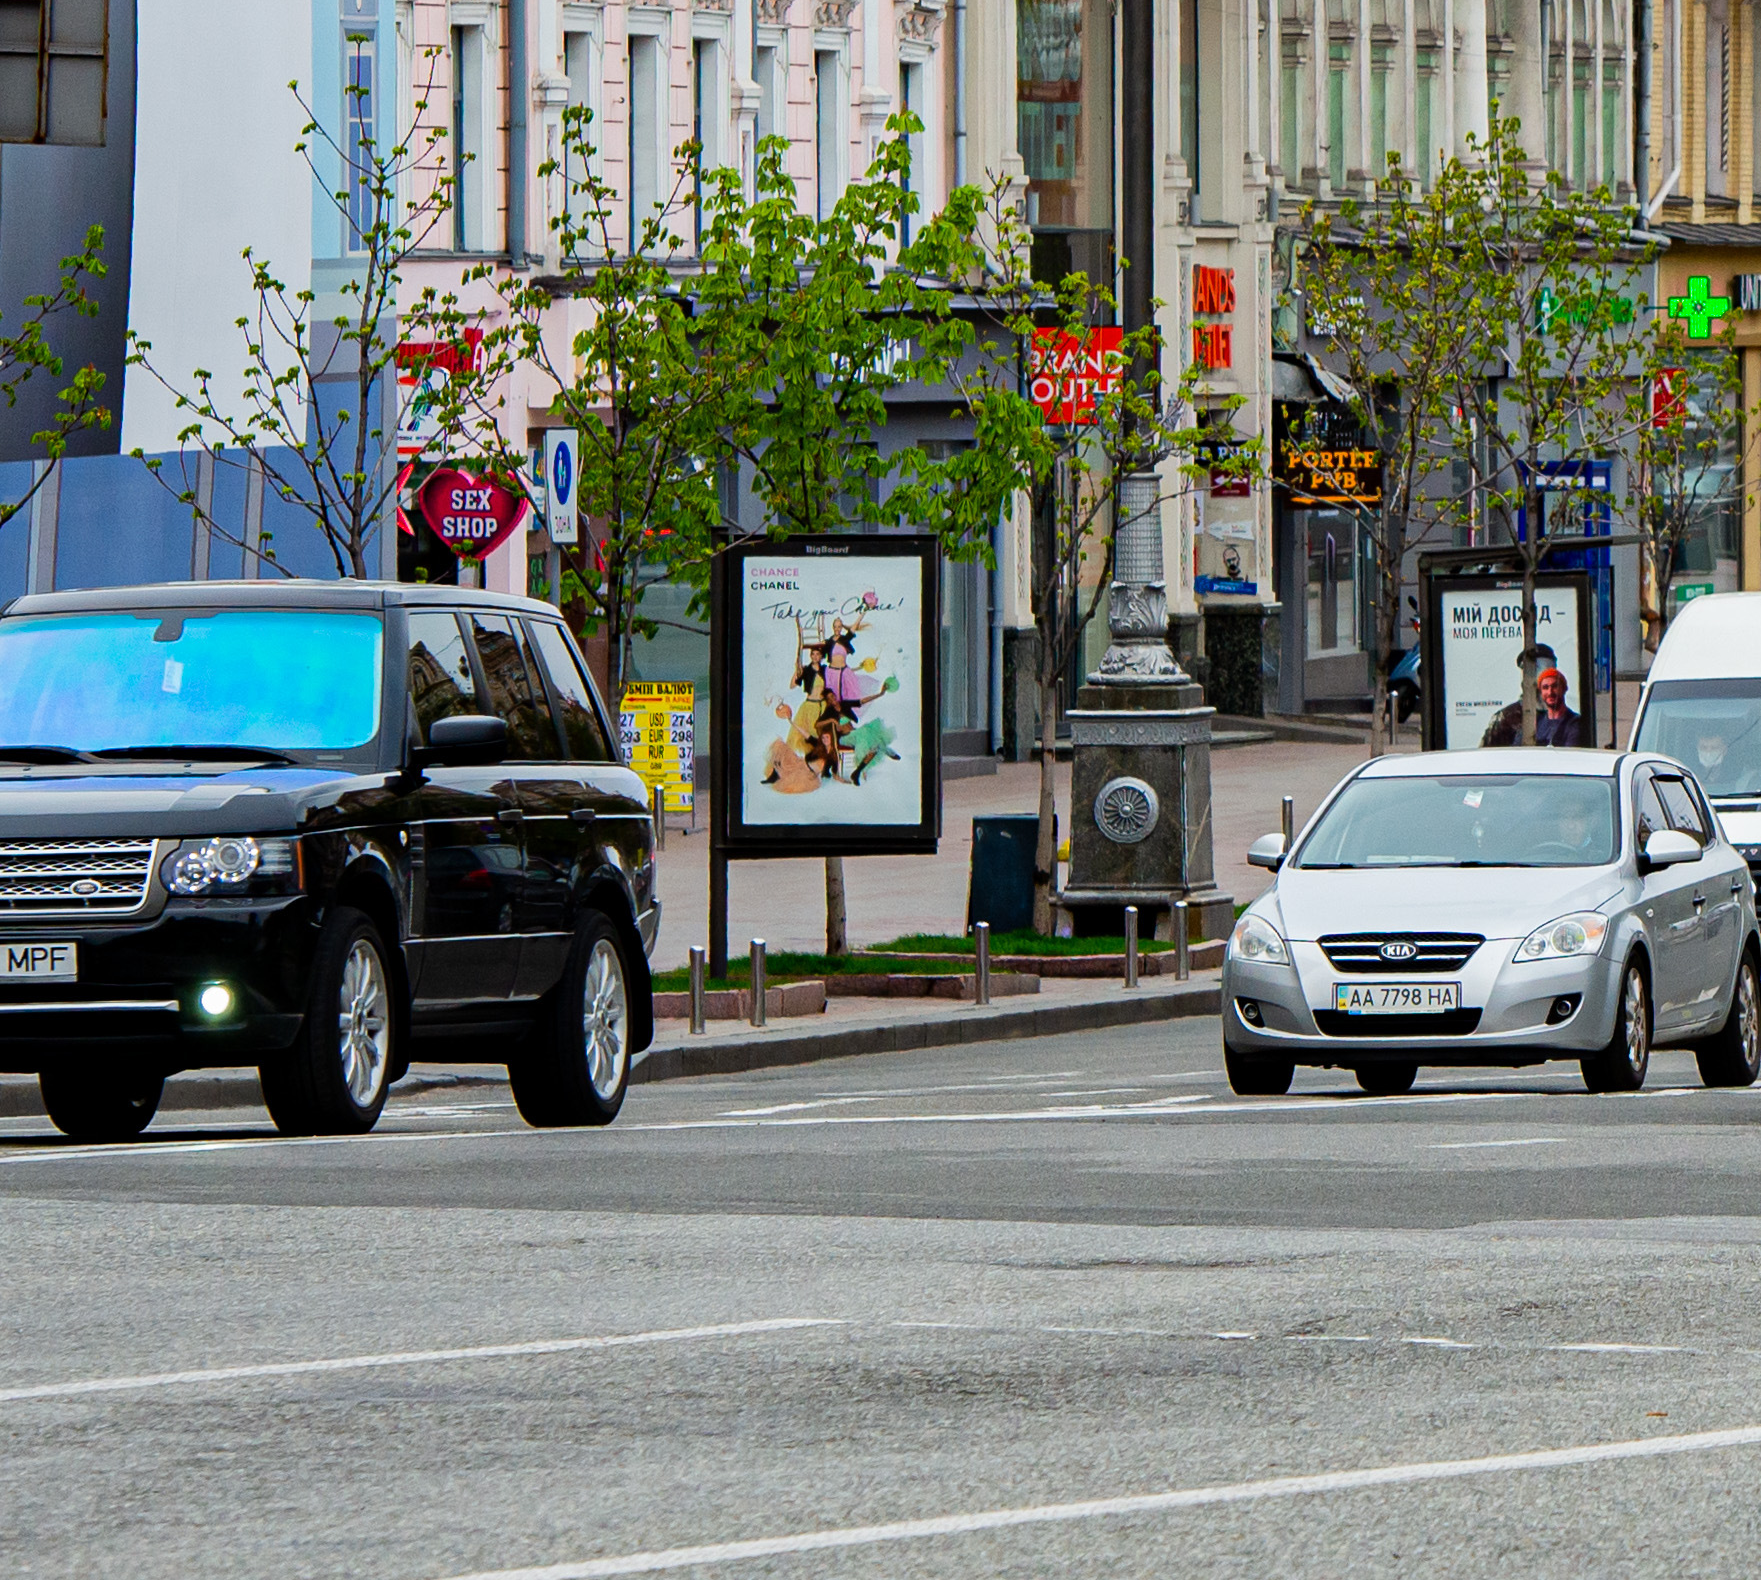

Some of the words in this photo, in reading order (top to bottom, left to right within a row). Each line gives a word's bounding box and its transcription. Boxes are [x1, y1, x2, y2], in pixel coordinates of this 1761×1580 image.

[1031, 349, 1123, 374] BRAND
[1311, 473, 1357, 489] PUB
[451, 489, 493, 511] SEX
[442, 517, 498, 538] SHOP
[751, 568, 799, 577] CHANCE
[751, 581, 799, 590] CHANEL
[761, 601, 809, 620] Take
[1453, 603, 1482, 624] МІЙ
[1488, 605, 1552, 626] ДОСД
[1453, 627, 1477, 639] МОЯ
[1482, 626, 1523, 639] ПЕРЕВА
[627, 683, 653, 695] БМІН
[657, 683, 693, 695] ВАЛЮТ
[649, 713, 664, 727] USD
[672, 713, 693, 727] 274
[649, 729, 664, 743] EUR
[671, 731, 693, 743] 298
[679, 747, 692, 759] 37
[1387, 946, 1410, 956] KIA
[8, 947, 68, 972] MPF
[1350, 989, 1374, 1007] AA
[1381, 988, 1421, 1006] 7798
[1428, 988, 1452, 1006] HA
